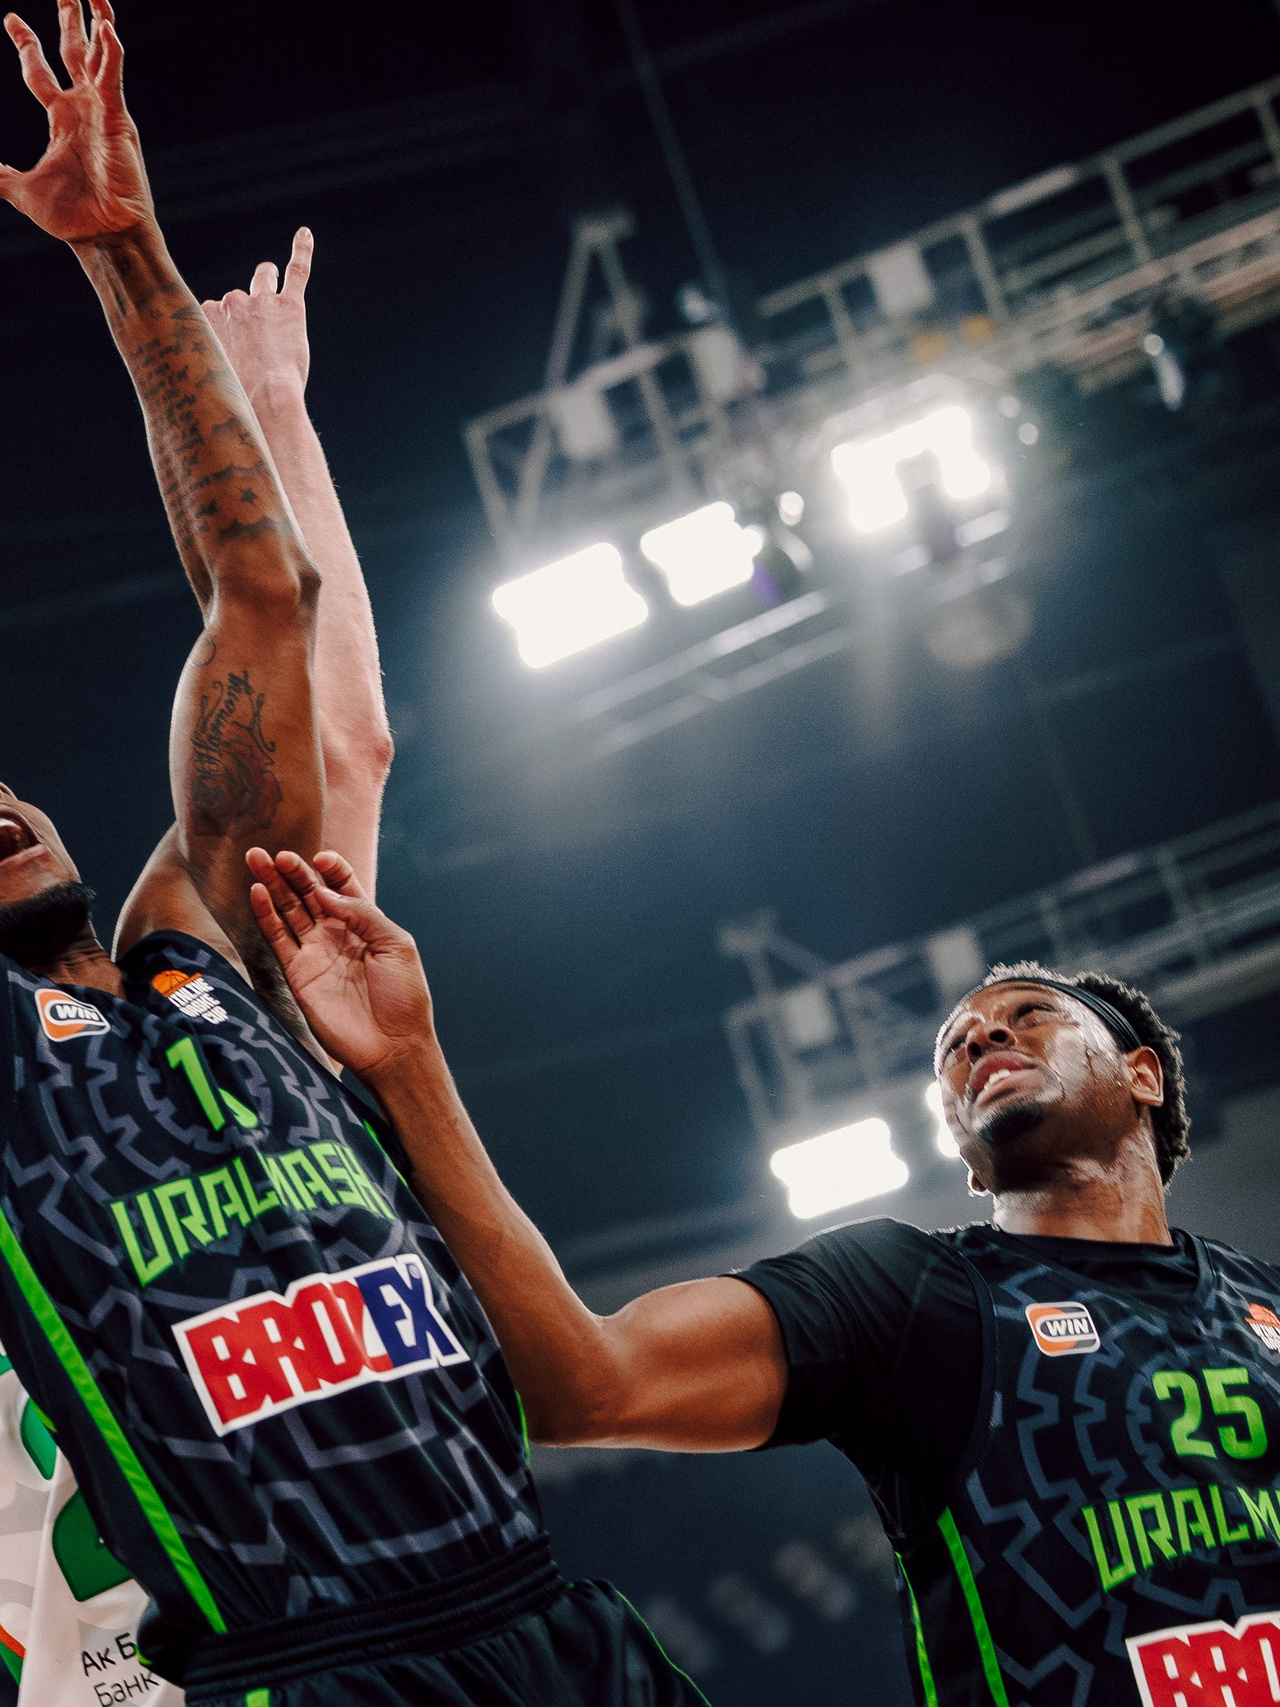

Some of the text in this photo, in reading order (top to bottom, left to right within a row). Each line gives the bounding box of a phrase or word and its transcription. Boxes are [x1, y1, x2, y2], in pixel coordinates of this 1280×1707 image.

[54, 1004, 101, 1022] WIN
[184, 1258, 459, 1425] BROZEX
[1045, 1317, 1089, 1337] WIN
[1151, 1367, 1269, 1460] 25
[81, 1647, 116, 1677] Ак
[93, 1671, 160, 1707] Банк
